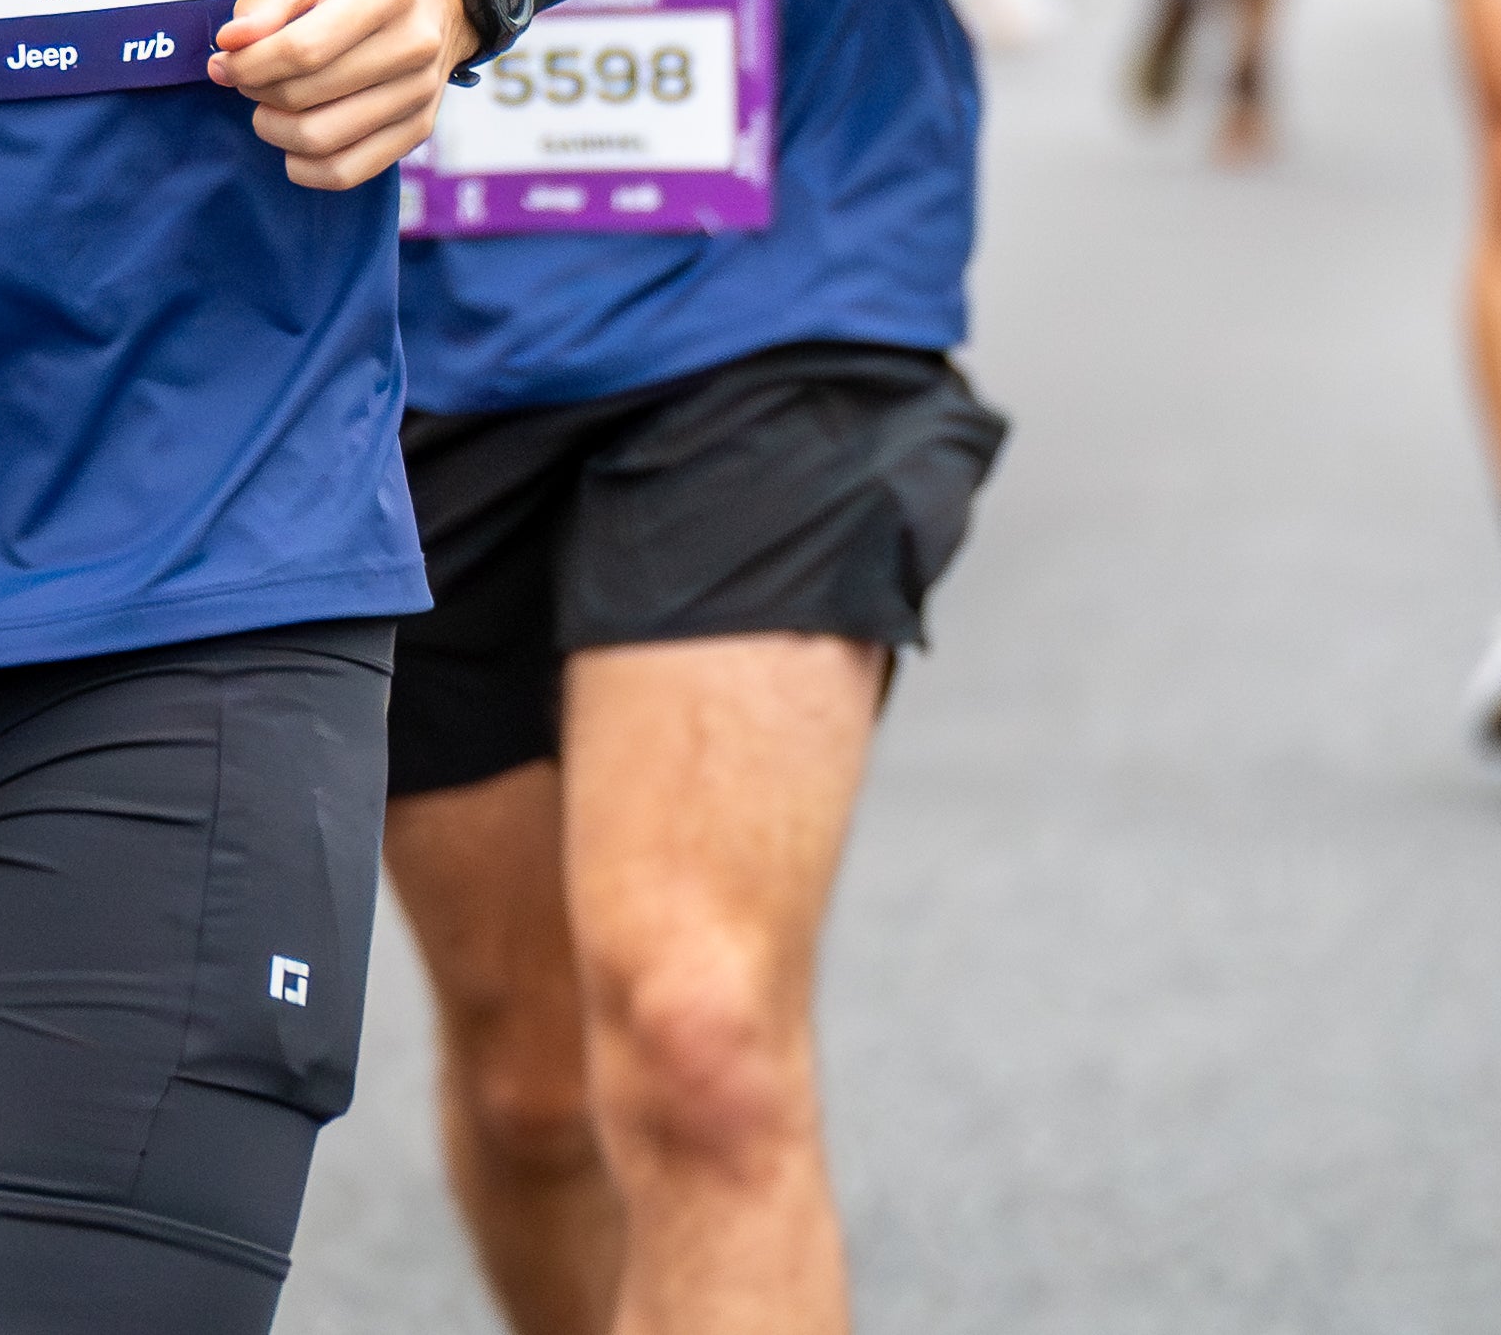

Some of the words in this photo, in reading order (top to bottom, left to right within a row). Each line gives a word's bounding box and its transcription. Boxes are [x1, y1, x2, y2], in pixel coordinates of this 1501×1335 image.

[6, 44, 78, 70] Jeep
[122, 31, 175, 62] rvb
[492, 44, 694, 105] 5598
